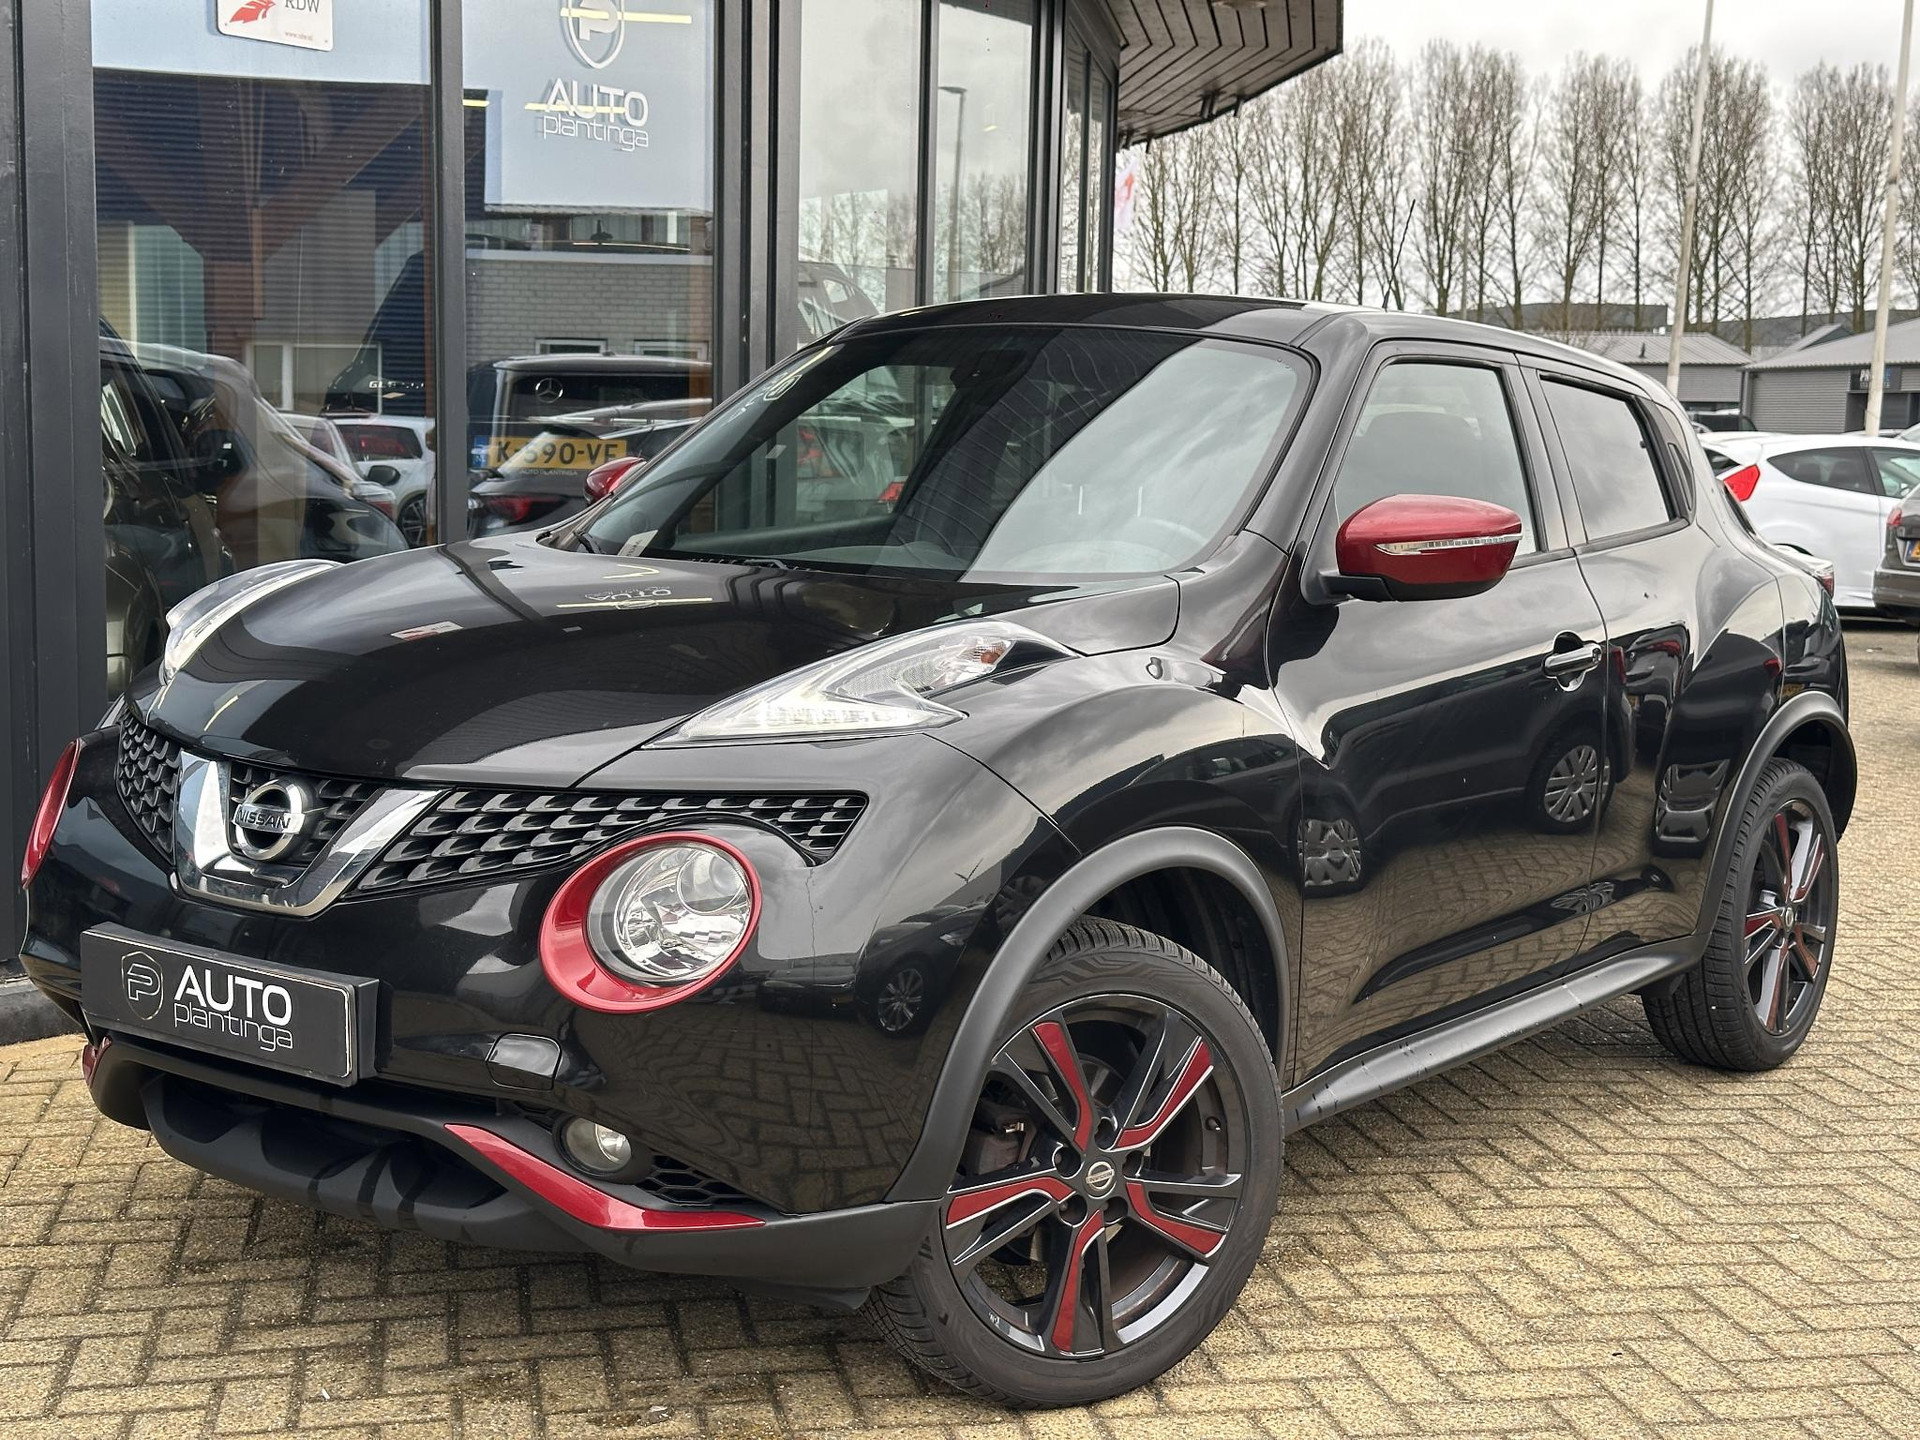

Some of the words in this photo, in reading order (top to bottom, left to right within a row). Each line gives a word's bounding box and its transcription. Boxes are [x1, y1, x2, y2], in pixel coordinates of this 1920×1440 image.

[285, 0, 320, 13] RDW
[545, 78, 649, 127] AUTO
[543, 113, 649, 152] plantinga
[235, 808, 291, 829] NISSAN
[174, 965, 292, 1027] AUTO
[174, 1002, 293, 1052] plantinga
